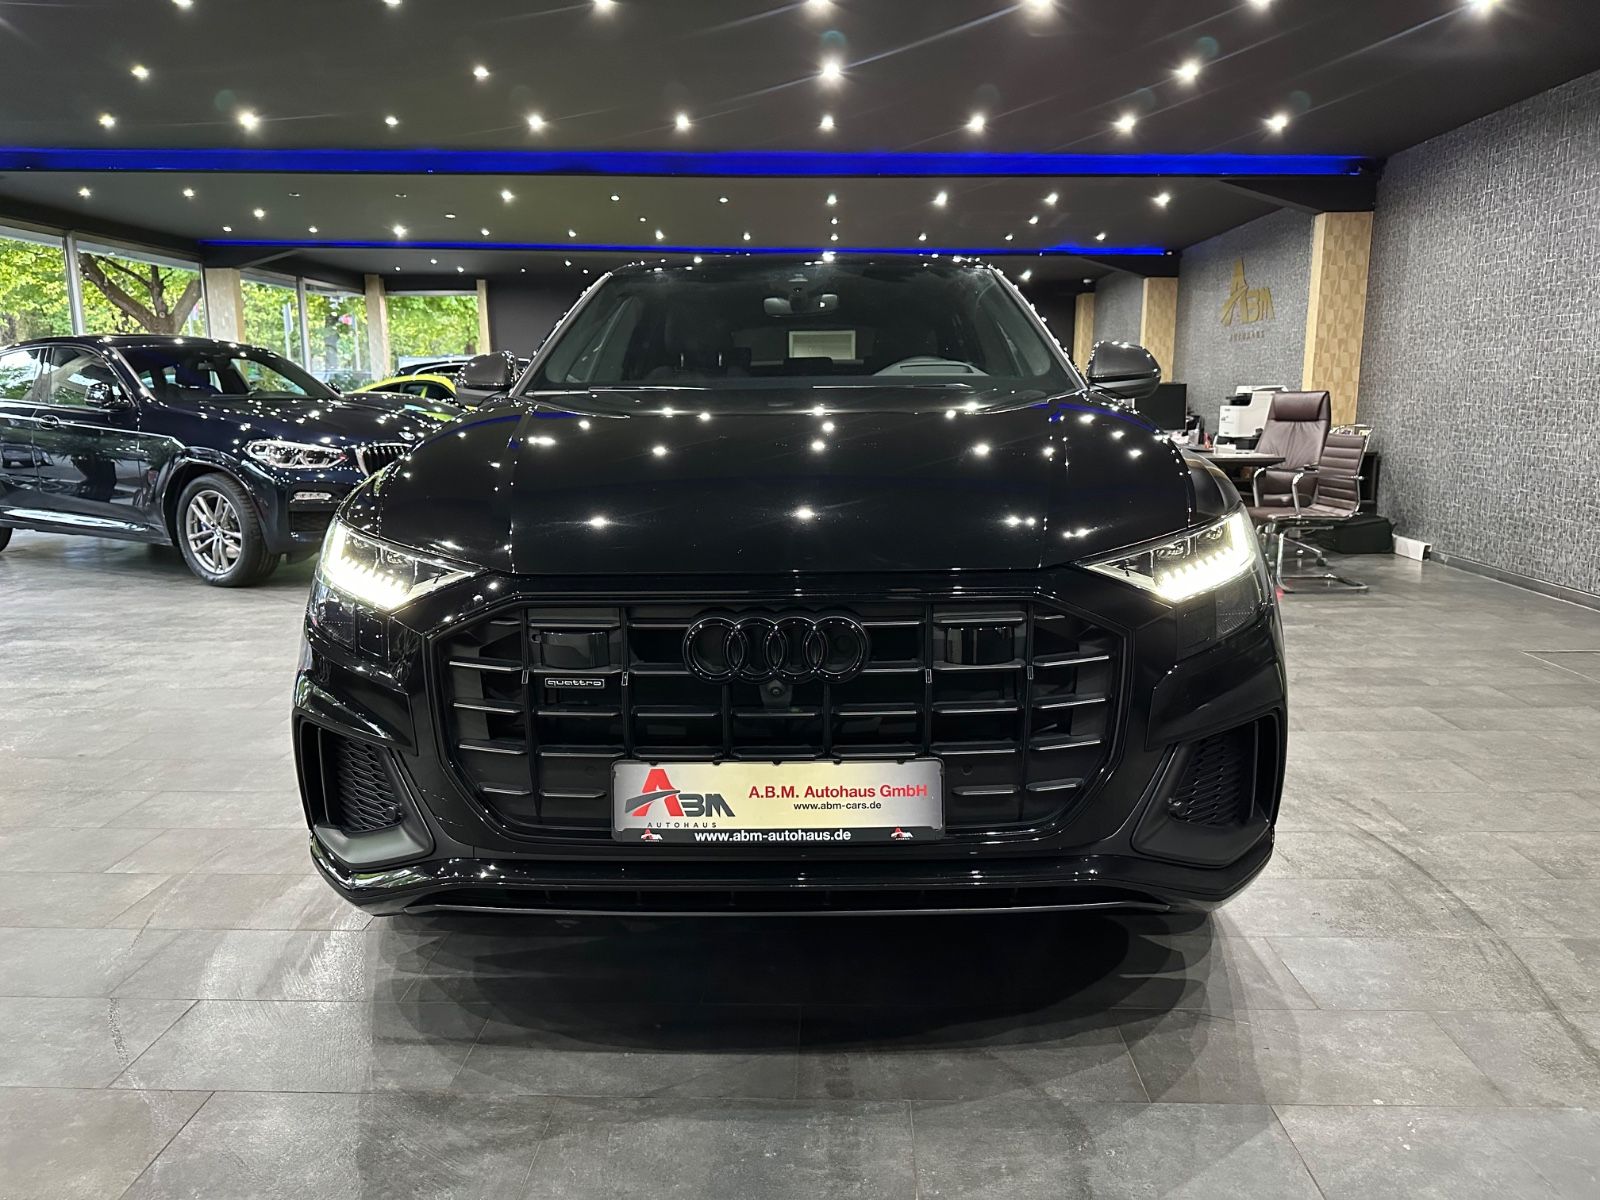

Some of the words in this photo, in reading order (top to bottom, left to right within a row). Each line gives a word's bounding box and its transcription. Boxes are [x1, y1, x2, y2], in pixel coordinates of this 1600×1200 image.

[1221, 256, 1275, 327] ABM
[625, 768, 735, 817] ABM
[748, 785, 800, 799] A.B.M.
[804, 785, 876, 798] Autohaus
[879, 783, 928, 797] GmbH
[793, 801, 882, 810] www.abm-cars.de
[694, 829, 852, 842] www.abm-autohaus.de
